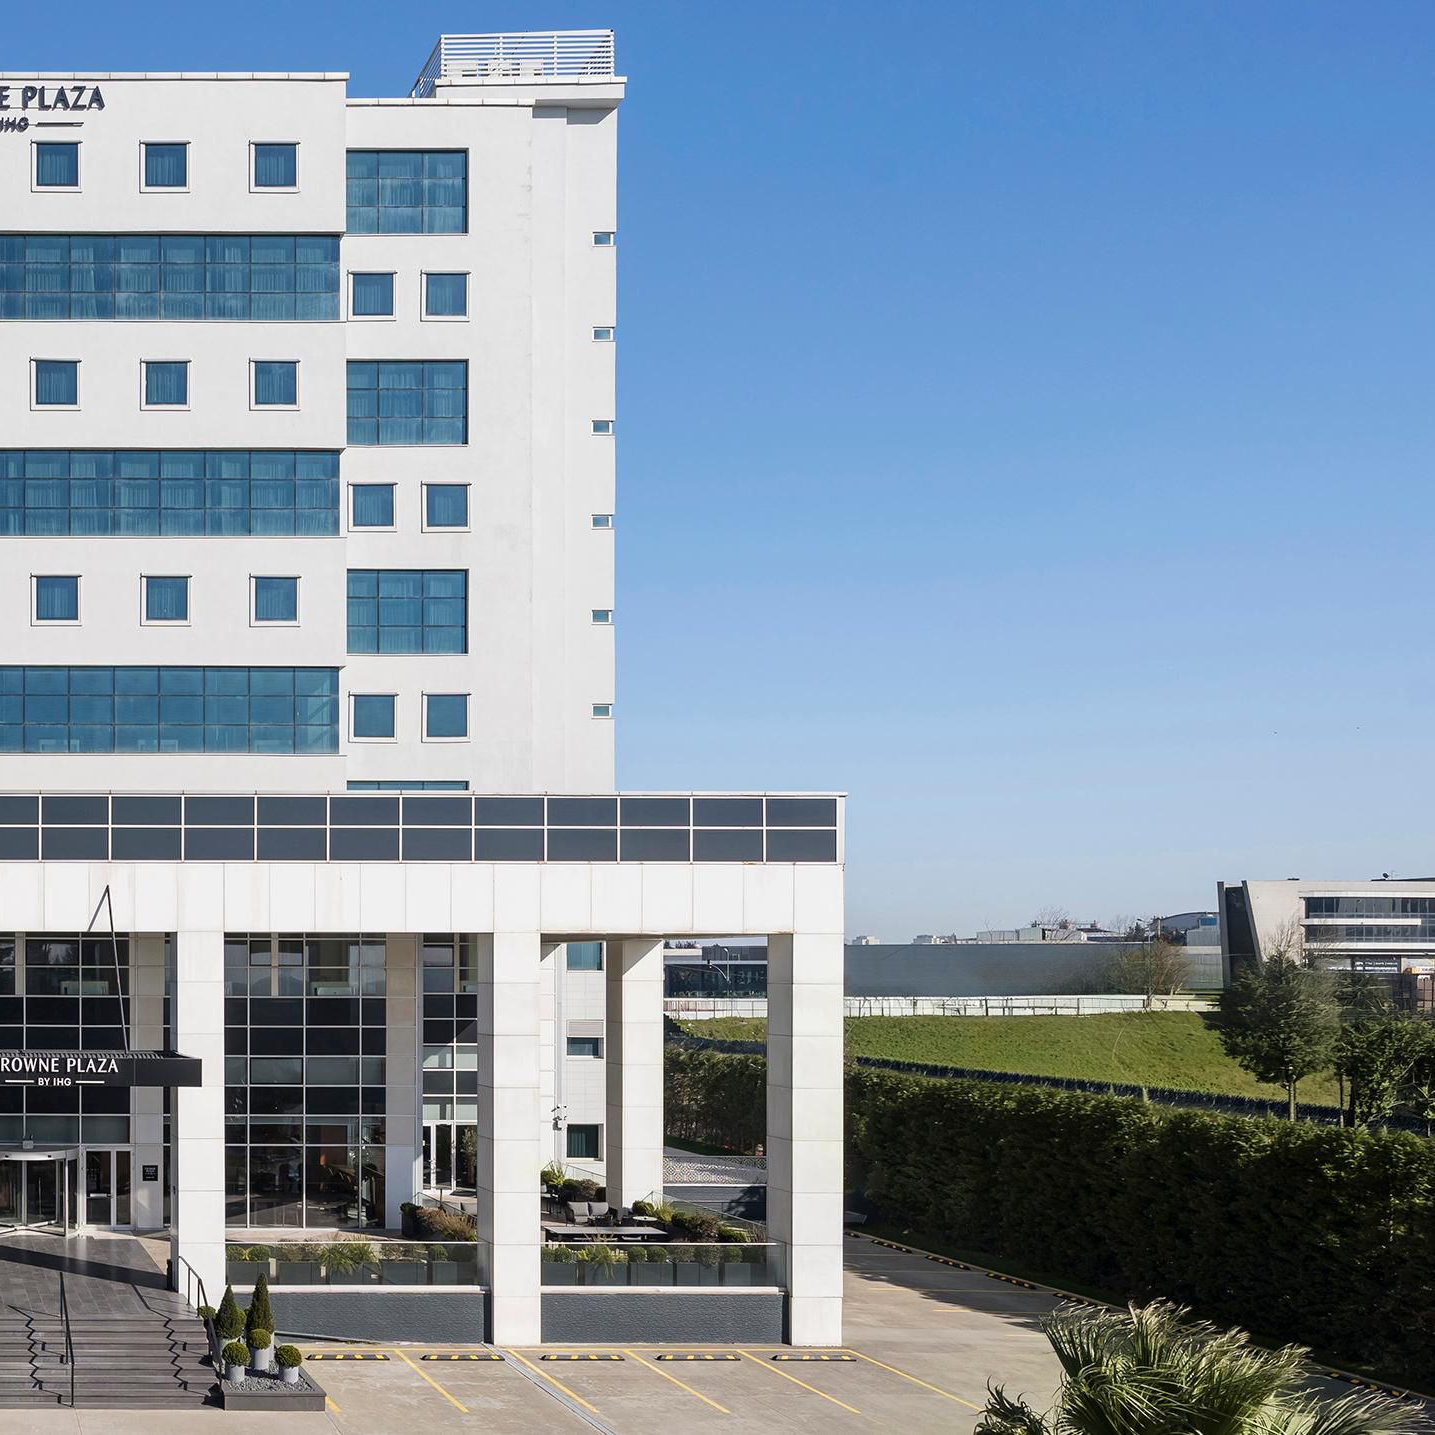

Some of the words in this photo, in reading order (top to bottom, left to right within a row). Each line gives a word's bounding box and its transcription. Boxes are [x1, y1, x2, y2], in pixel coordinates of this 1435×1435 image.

[21, 86, 106, 111] PLAZA
[66, 1058, 119, 1073] PLAZA
[38, 1077, 51, 1086] BY
[53, 1077, 72, 1086] IHG
